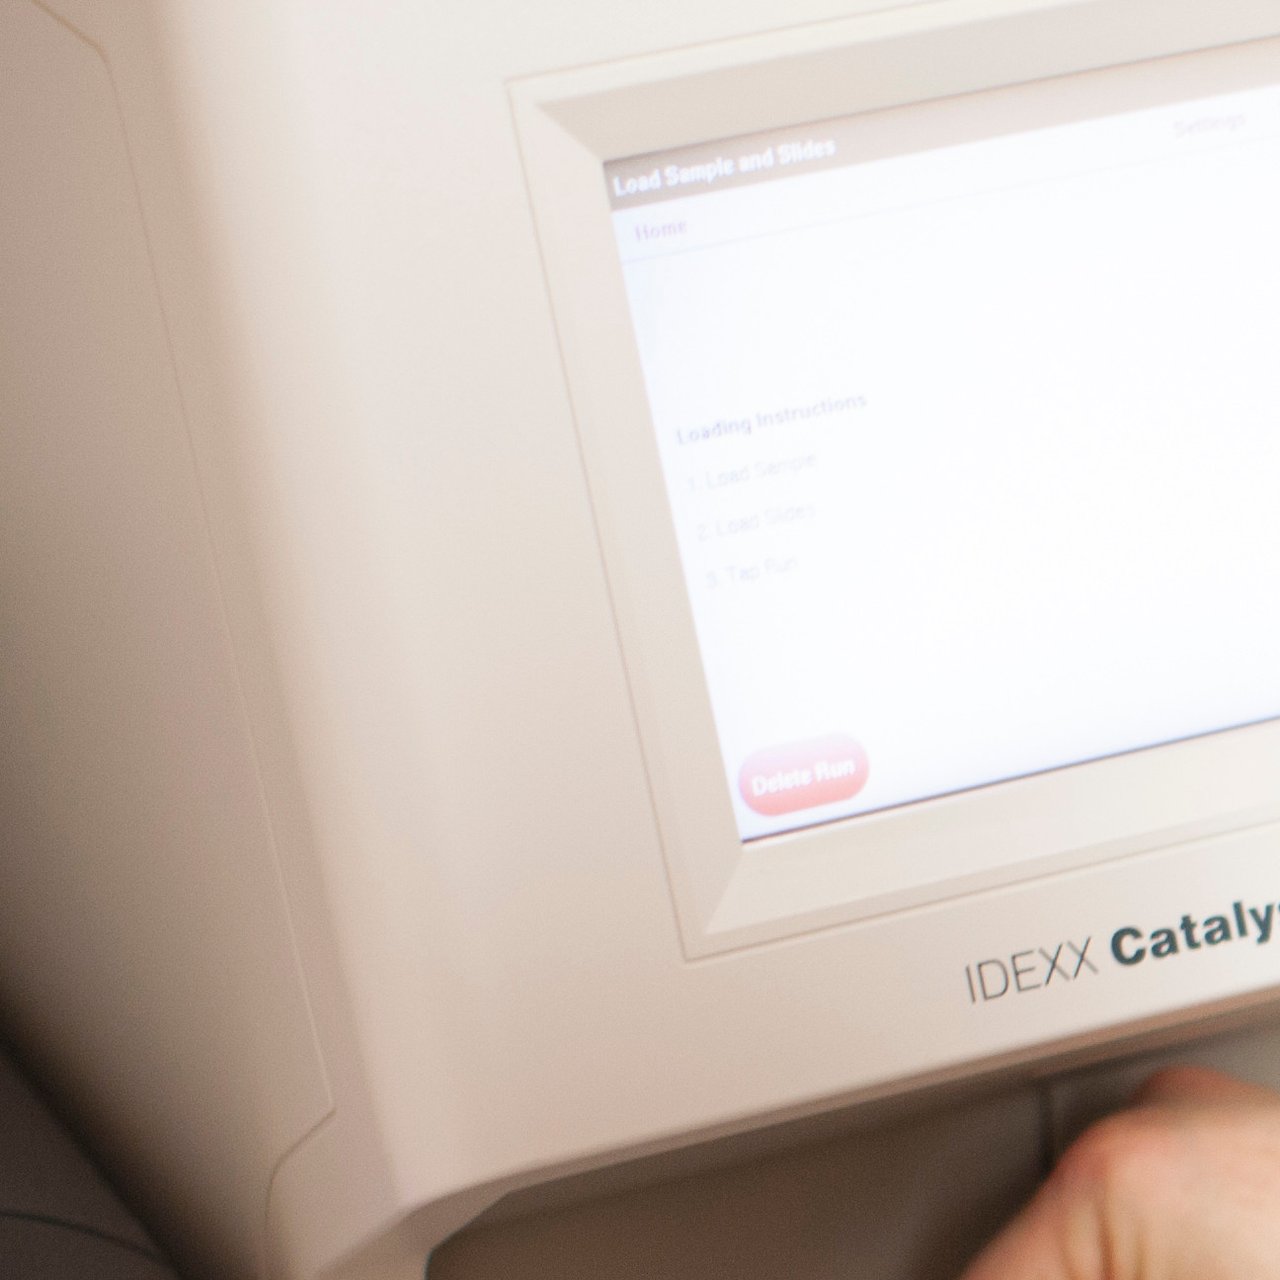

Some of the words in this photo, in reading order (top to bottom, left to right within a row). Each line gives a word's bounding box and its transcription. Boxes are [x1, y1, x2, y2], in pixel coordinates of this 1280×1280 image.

[613, 167, 662, 197] Load
[665, 157, 735, 186] Sample
[738, 147, 775, 173] and
[777, 139, 837, 165] Slides
[634, 219, 688, 244] Home
[676, 418, 752, 445] Loading
[755, 394, 867, 428] Instructions
[751, 768, 813, 797] Delete
[814, 759, 857, 783] Run
[965, 937, 1100, 1004] IDEXX
